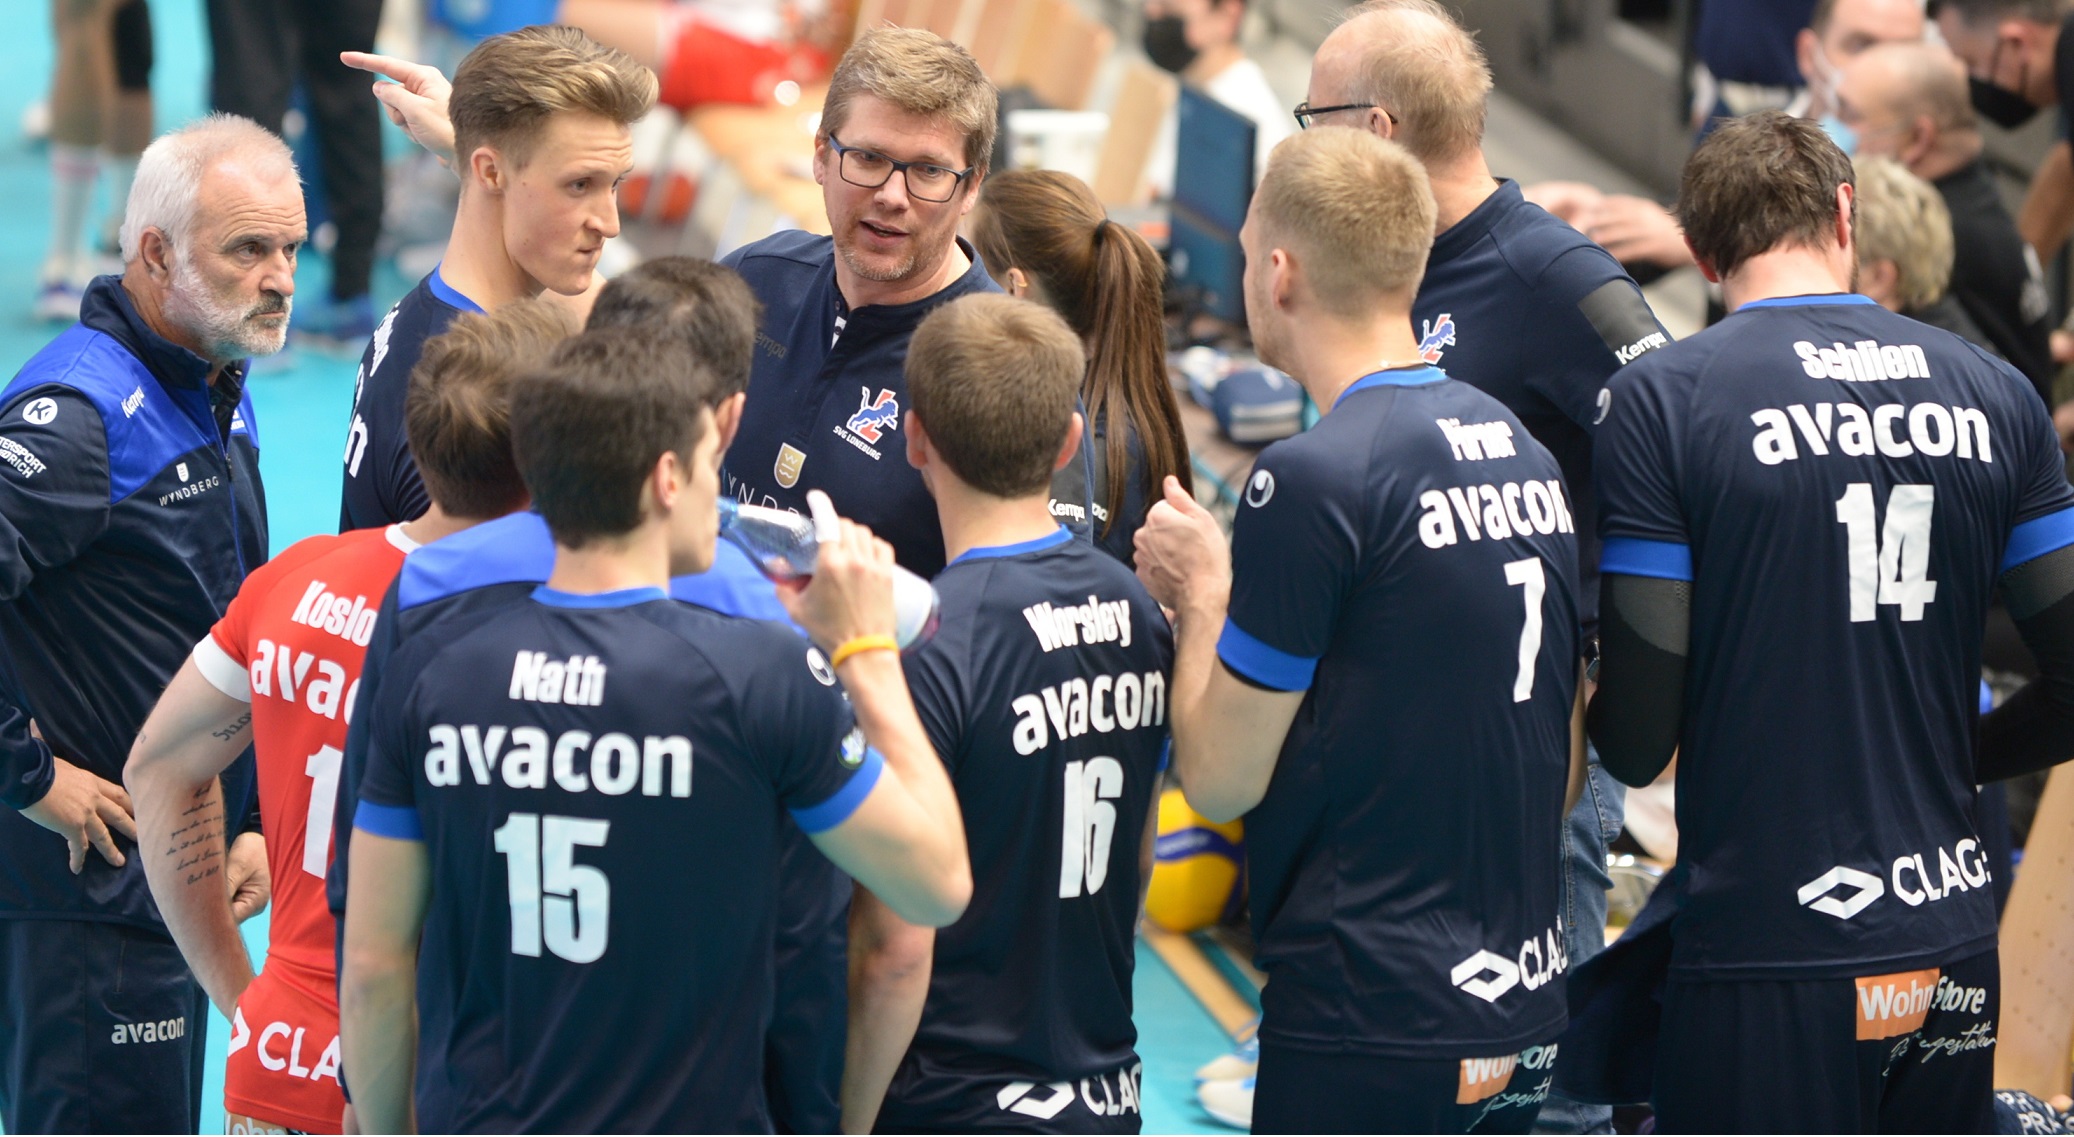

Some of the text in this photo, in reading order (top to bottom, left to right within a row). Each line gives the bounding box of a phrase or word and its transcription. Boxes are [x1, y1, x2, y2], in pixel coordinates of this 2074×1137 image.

[754, 331, 787, 360] empa
[1615, 332, 1667, 366] Kempa
[1793, 340, 1931, 382] Schlien
[1750, 402, 1993, 465] avacon
[159, 475, 220, 507] WYNDBERG
[1418, 480, 1575, 549] avacon
[1835, 482, 1938, 622] 14
[1022, 595, 1132, 653] Worsley
[1504, 556, 1546, 703] 7
[508, 650, 607, 706] Nath
[1012, 669, 1165, 756] avacon
[424, 724, 693, 798] avacon
[1059, 756, 1123, 899] 16
[494, 813, 611, 964] 15
[111, 1015, 184, 1045] avacon
